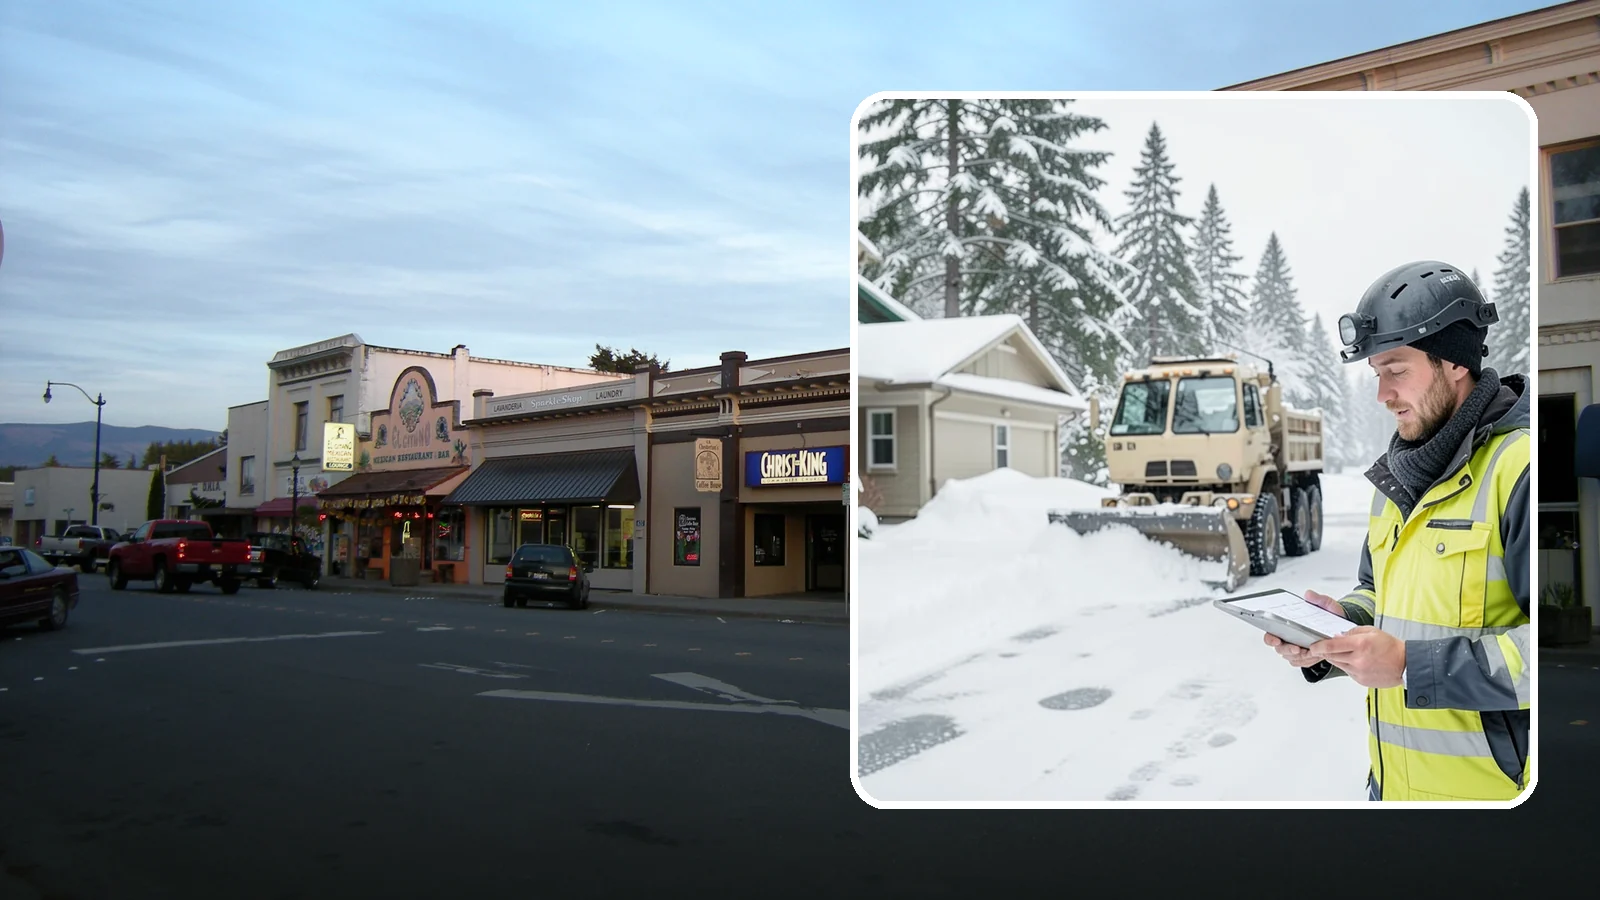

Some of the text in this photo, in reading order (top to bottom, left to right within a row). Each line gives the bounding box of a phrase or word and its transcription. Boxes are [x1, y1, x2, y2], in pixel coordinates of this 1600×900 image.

[595, 389, 624, 400] LAUNDRY
[493, 402, 523, 413] LAVANDERIA
[530, 395, 583, 409] Sparkle Shop
[373, 455, 396, 464] MEXICAN
[398, 451, 434, 462] RESTAURANT
[437, 450, 450, 459] BAR
[760, 450, 827, 478] CHRIST KING
